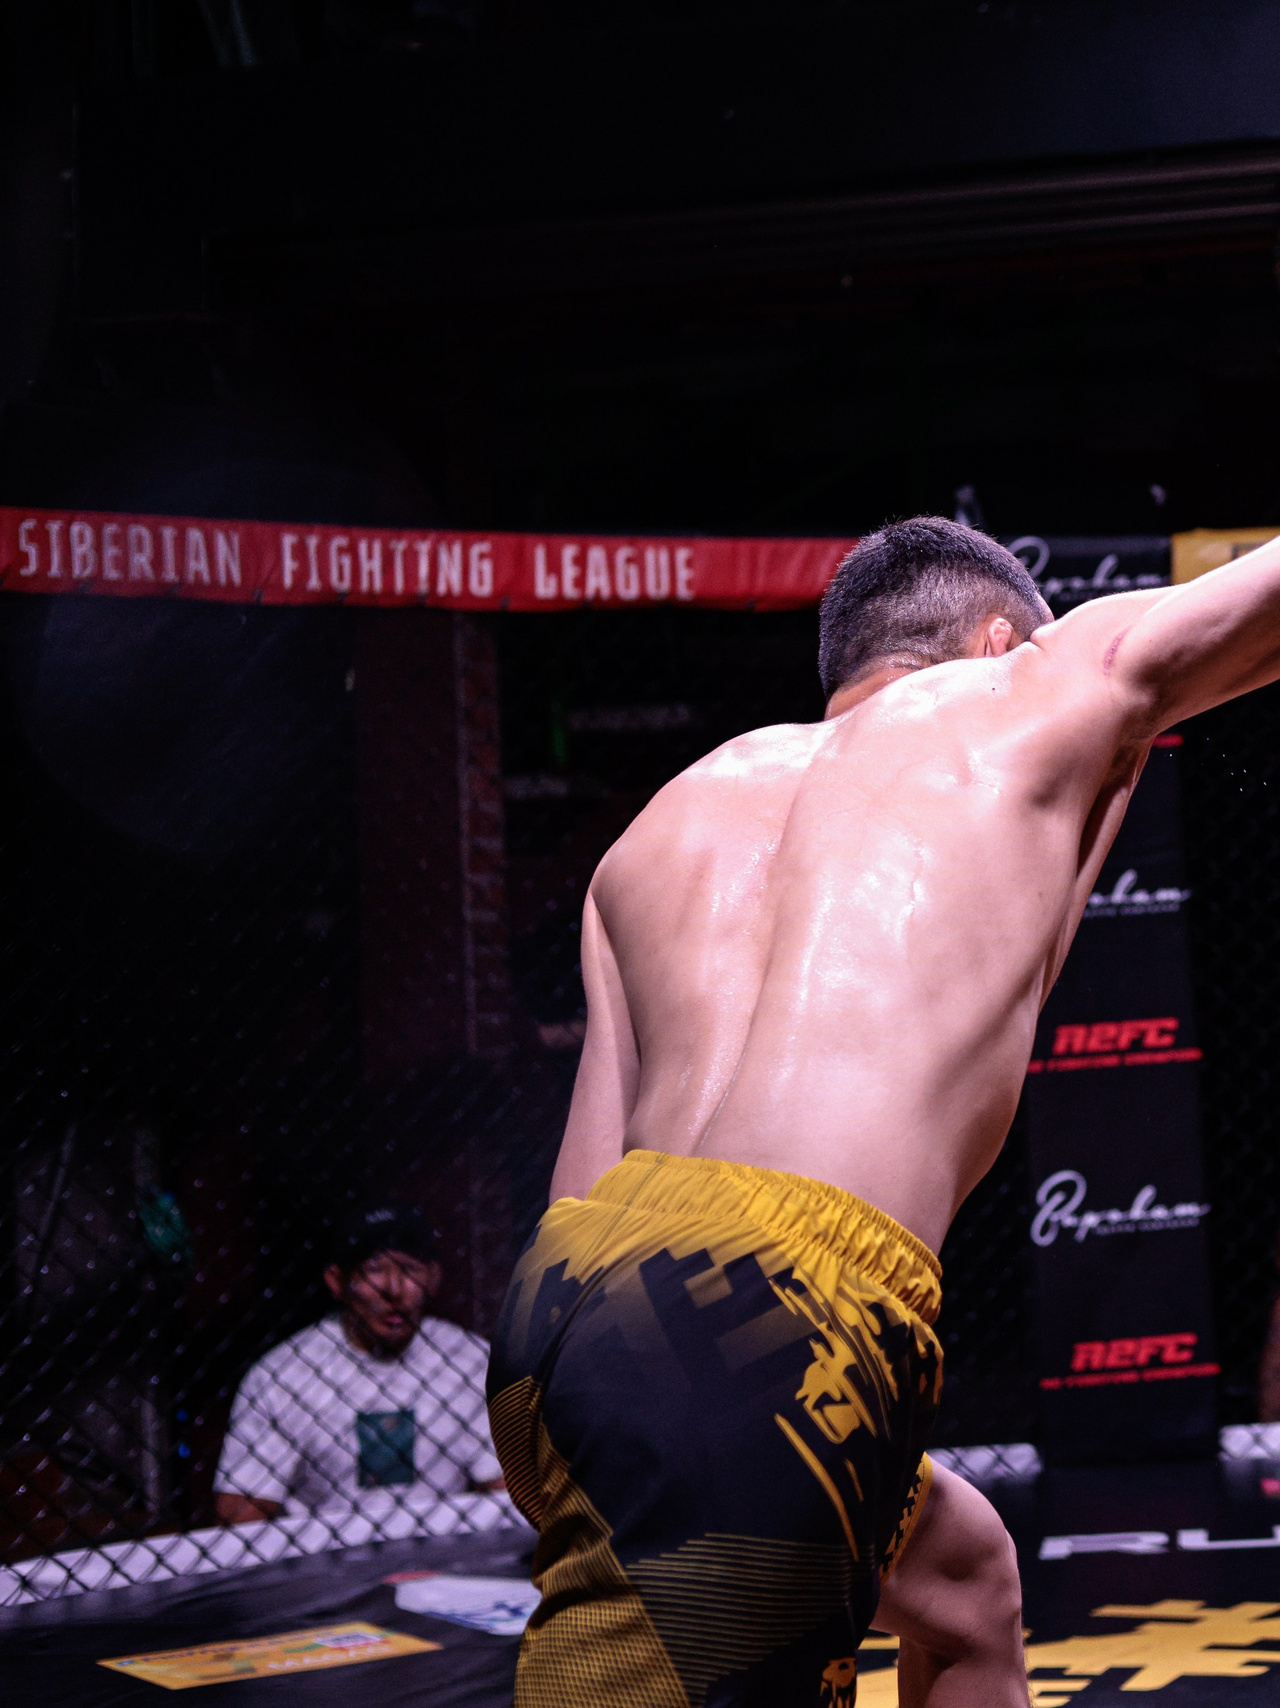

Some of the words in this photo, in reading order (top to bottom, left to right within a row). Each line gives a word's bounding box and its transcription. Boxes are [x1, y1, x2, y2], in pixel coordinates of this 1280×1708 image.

[18, 518, 242, 587] SIBERIAN
[281, 533, 493, 598] FIGHTING
[534, 543, 696, 601] LEAGUE
